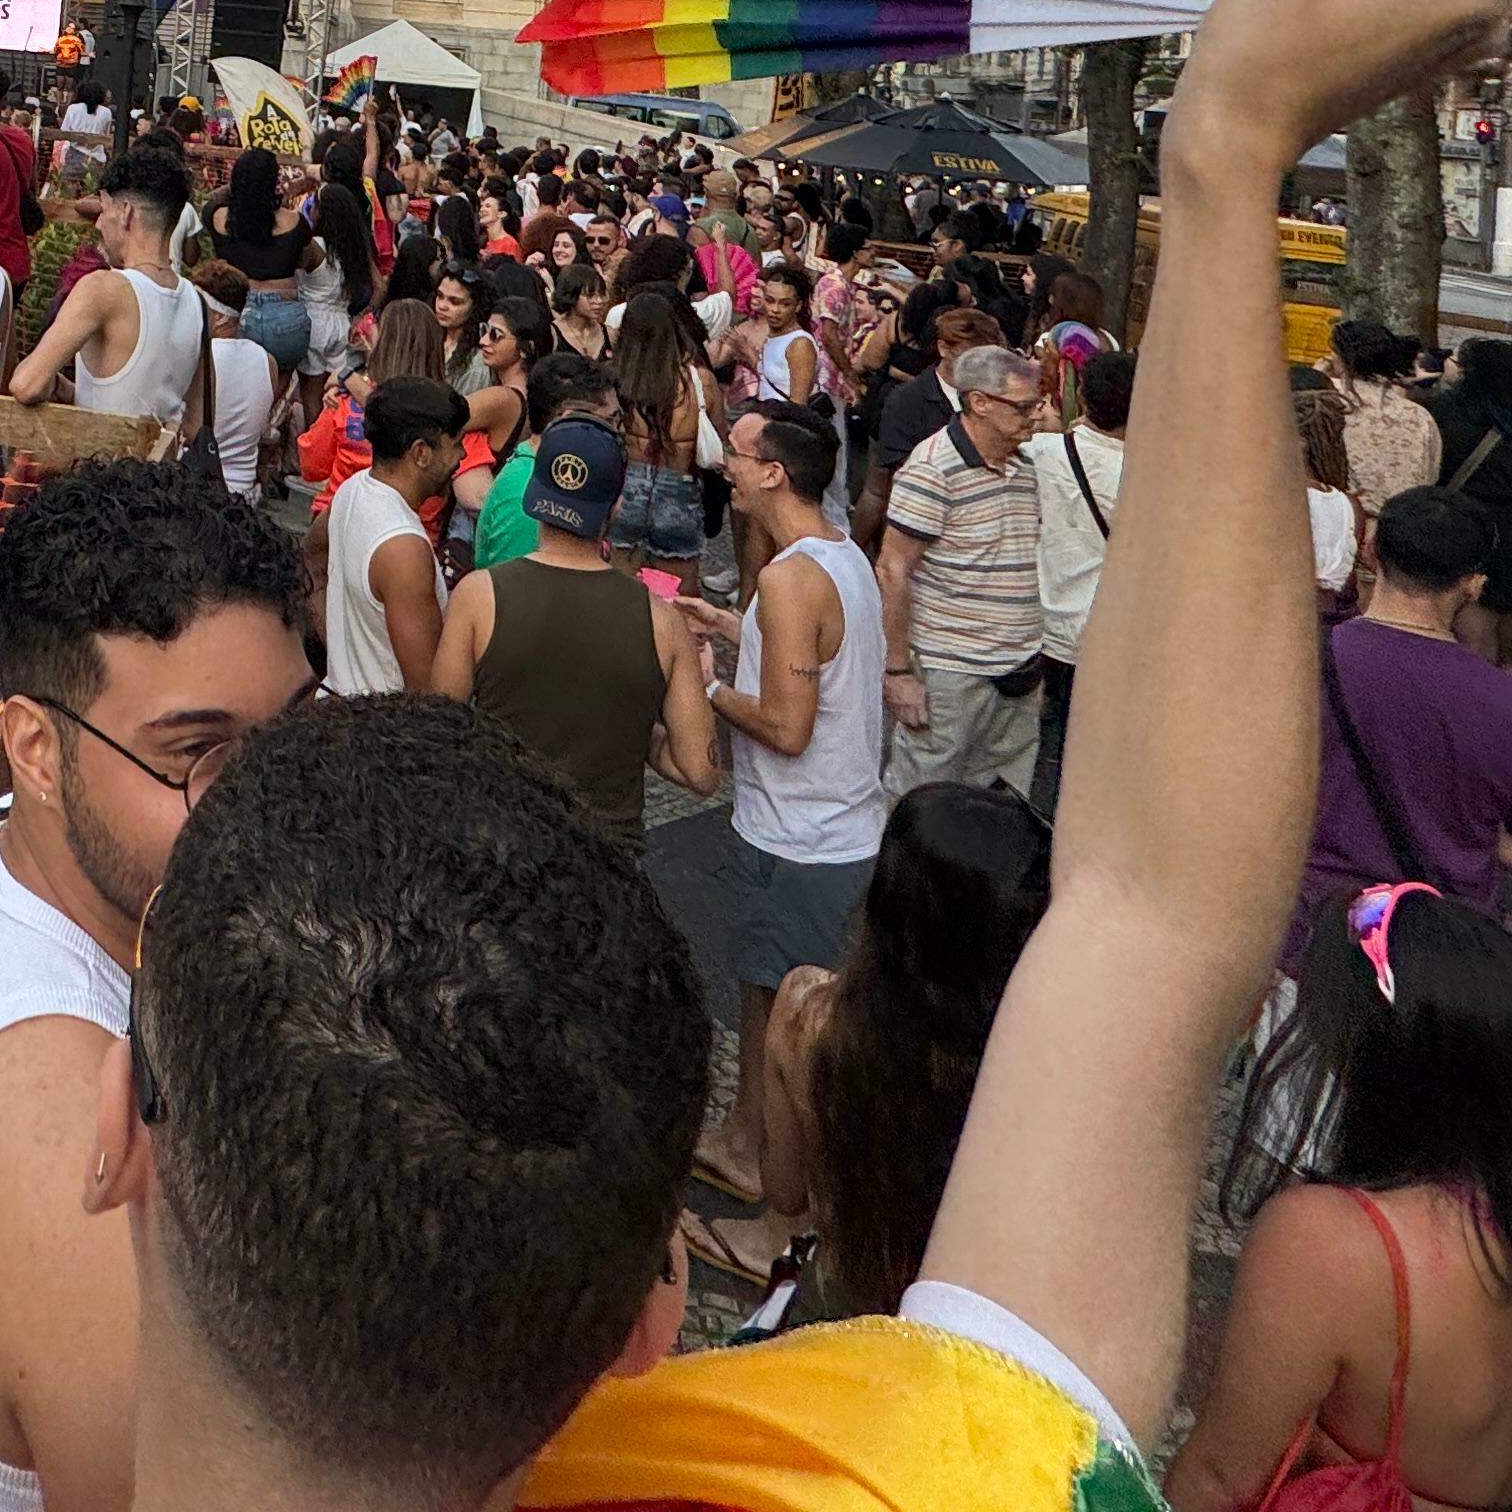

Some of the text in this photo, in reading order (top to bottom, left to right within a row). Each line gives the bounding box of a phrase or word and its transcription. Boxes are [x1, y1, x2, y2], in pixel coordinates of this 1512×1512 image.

[267, 104, 278, 117] A
[933, 155, 1000, 172] ESTIVA
[532, 499, 584, 528] PARIS
